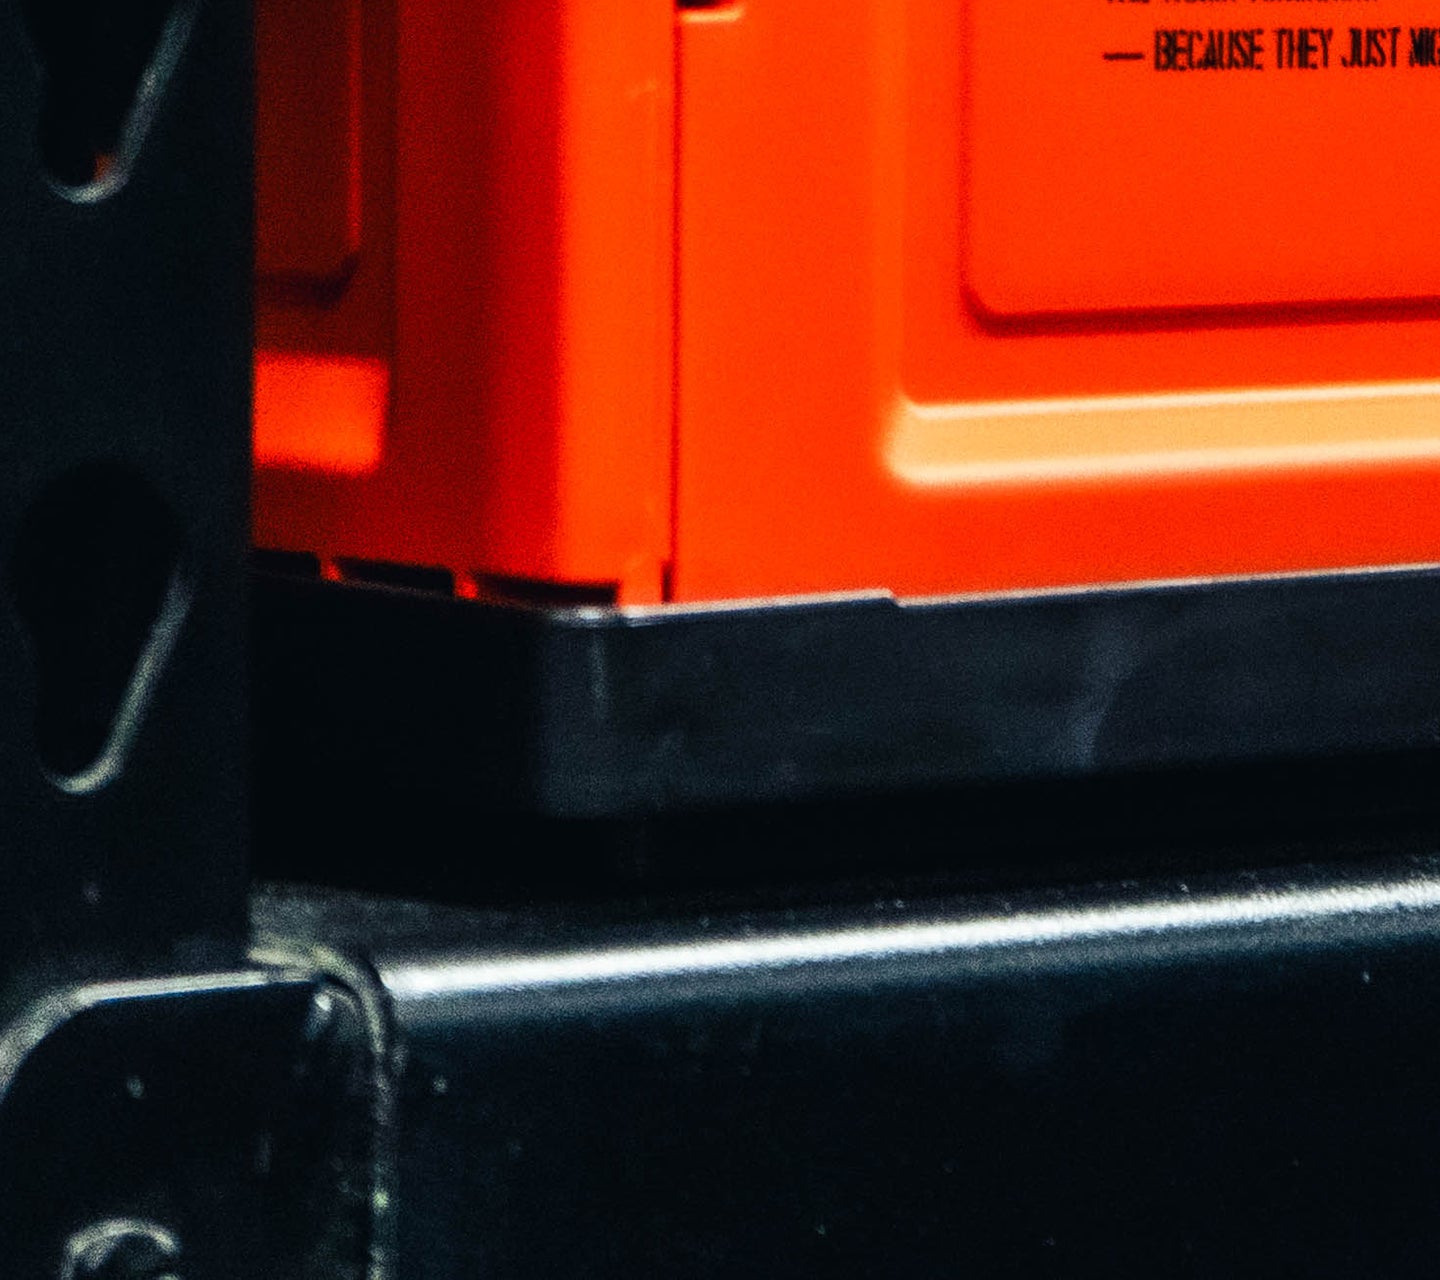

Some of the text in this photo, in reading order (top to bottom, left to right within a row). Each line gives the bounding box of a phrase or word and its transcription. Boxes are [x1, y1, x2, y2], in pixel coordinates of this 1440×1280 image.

[1154, 28, 1265, 71] BECAUSE
[1272, 28, 1333, 70] THEY
[1341, 26, 1401, 68] JUST
